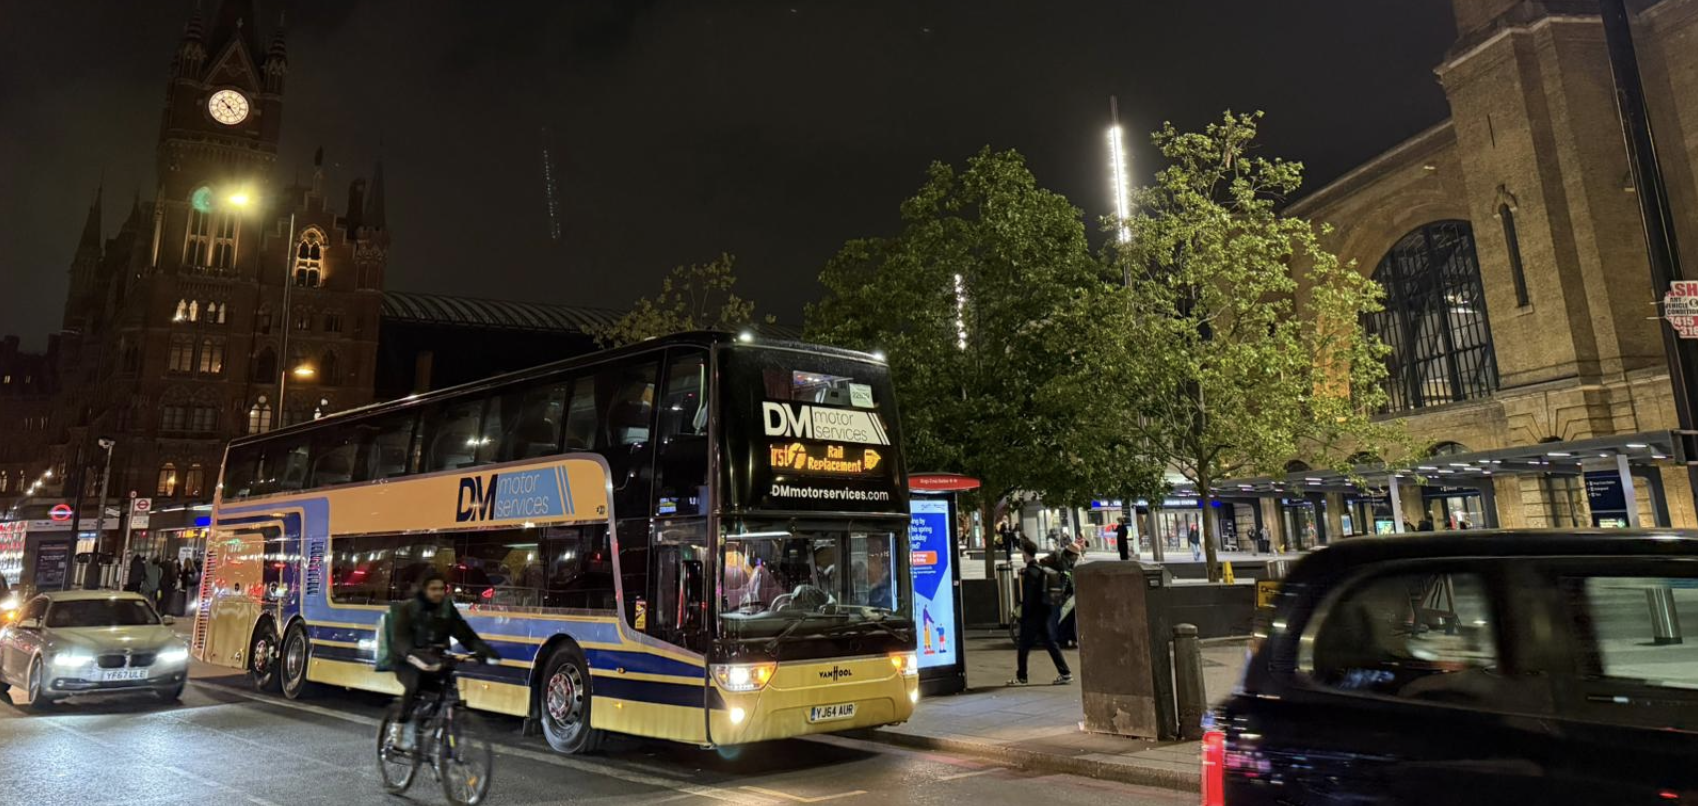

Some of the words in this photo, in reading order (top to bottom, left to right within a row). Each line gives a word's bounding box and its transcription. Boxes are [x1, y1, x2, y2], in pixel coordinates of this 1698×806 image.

[762, 401, 813, 439] DM
[814, 411, 854, 426] motor
[815, 425, 868, 442] services
[828, 445, 844, 459] Rail
[807, 456, 862, 472] Replacement
[456, 474, 498, 522] DM
[498, 472, 540, 495] motor
[771, 485, 889, 501] DMmotorservices.com
[497, 495, 549, 518] services
[816, 707, 836, 718] YJ64
[838, 704, 854, 716] AUR
